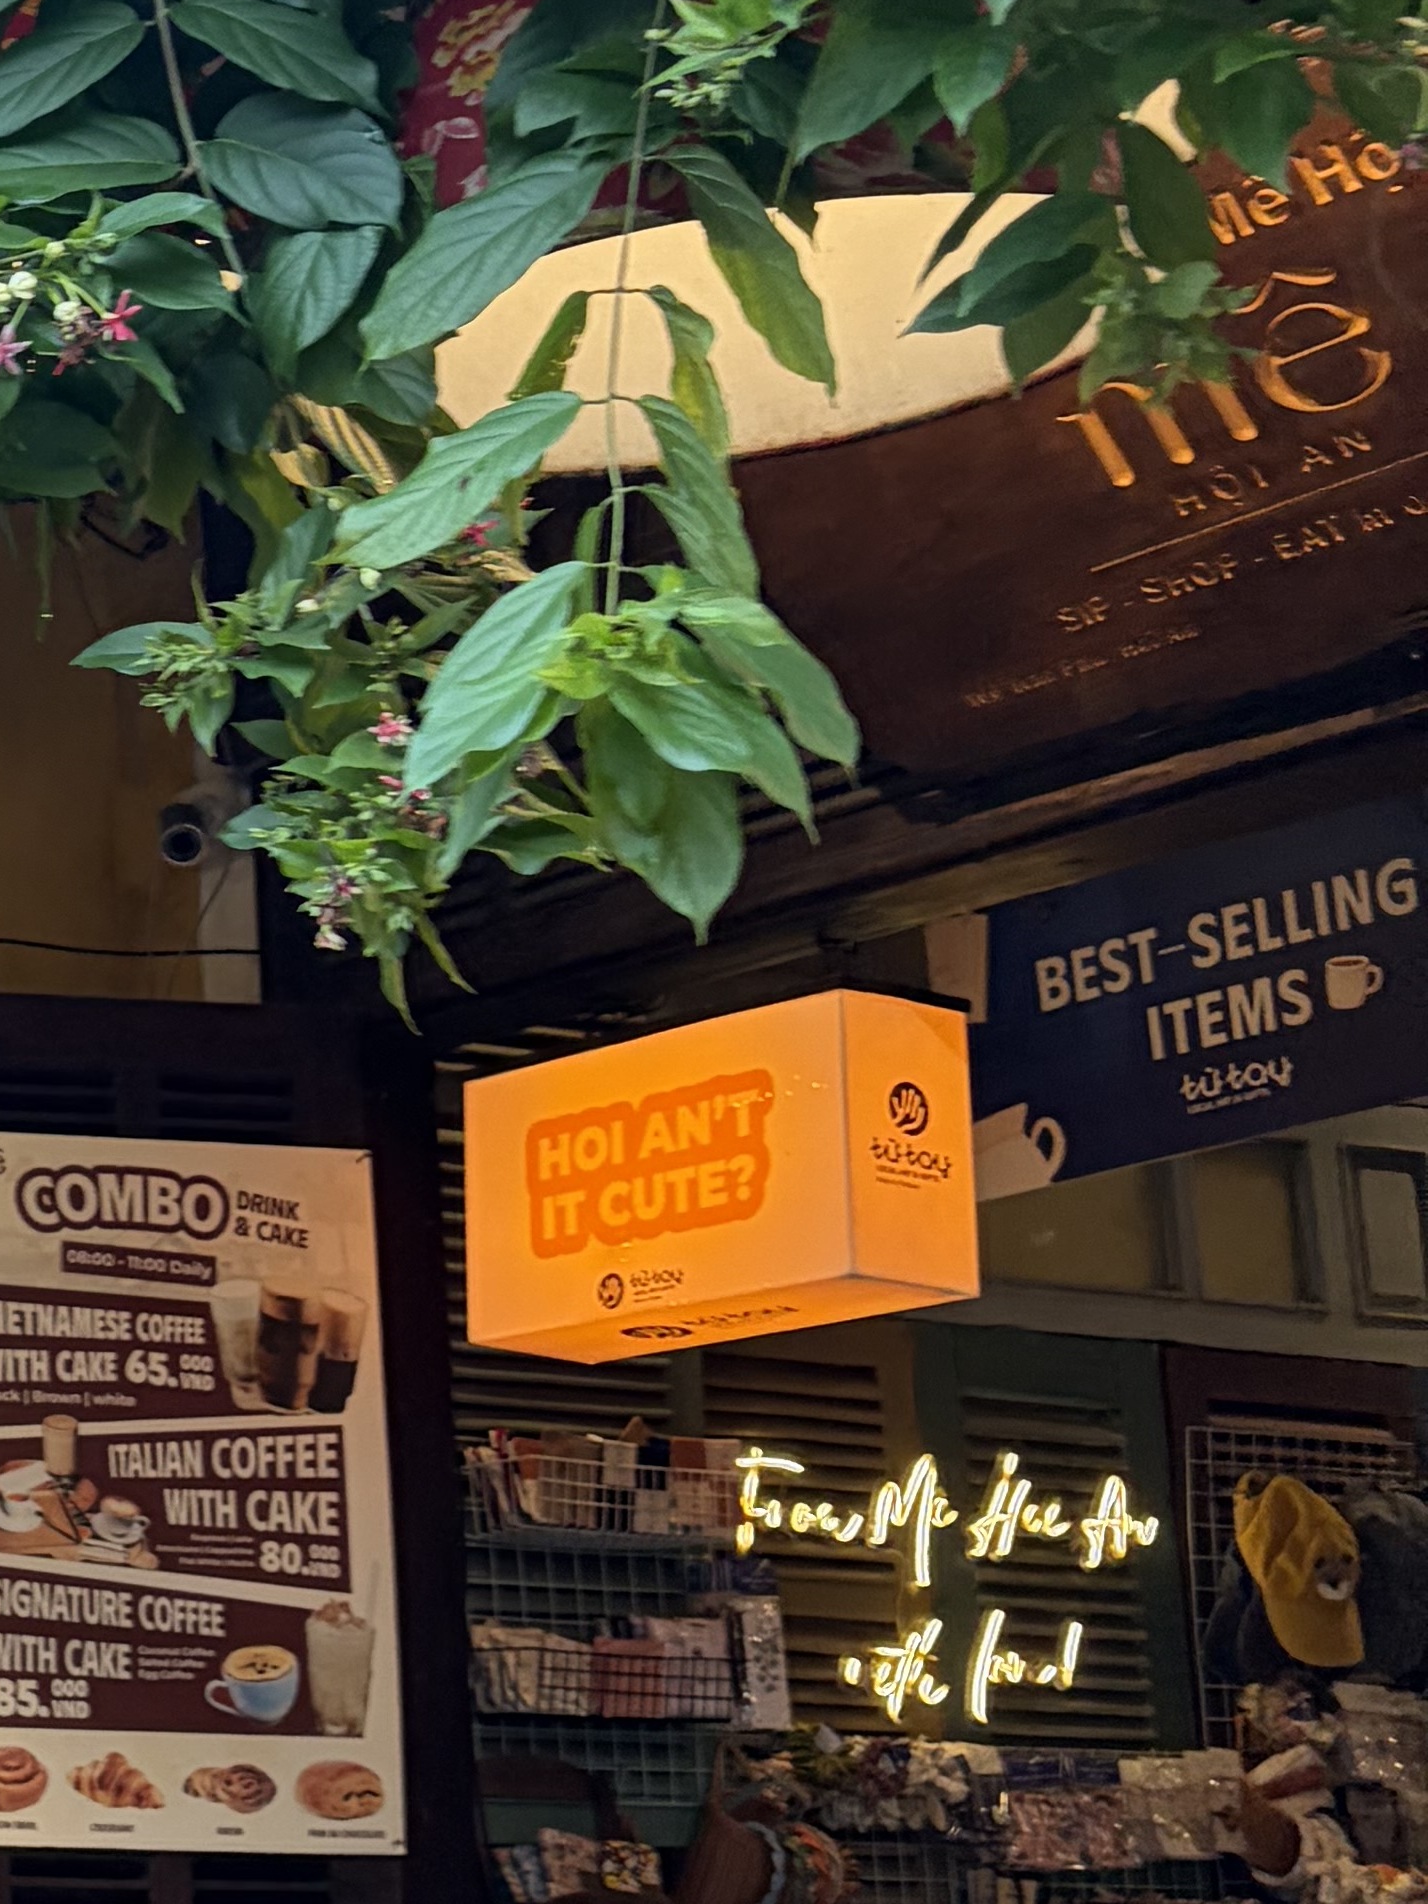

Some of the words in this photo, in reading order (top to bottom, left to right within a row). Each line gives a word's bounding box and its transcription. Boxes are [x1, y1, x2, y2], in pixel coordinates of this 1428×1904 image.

[1301, 429, 1373, 474] AN
[1056, 596, 1110, 633] SIP
[1140, 553, 1239, 603] SHOP
[1271, 514, 1347, 561] EAT
[1147, 968, 1314, 1061] ITEMS
[538, 1119, 626, 1181] HOI
[639, 1087, 761, 1159] AN'T
[18, 1168, 227, 1237] COMBO
[236, 1190, 300, 1221] DRINK
[542, 1190, 586, 1241] IT
[597, 1153, 756, 1228] CUTE?
[234, 1216, 250, 1236] &
[256, 1220, 310, 1249] CAKE
[169, 1259, 213, 1280] Daily
[135, 1312, 207, 1345] COFFEE
[55, 1349, 120, 1383] CAKE
[108, 1440, 205, 1479] ITALIAN
[211, 1433, 341, 1480] COFFEE
[162, 1488, 239, 1529] WITH
[245, 1489, 341, 1537] CAKE
[138, 1595, 227, 1638] COFFEE
[64, 1639, 133, 1680] CAKE
